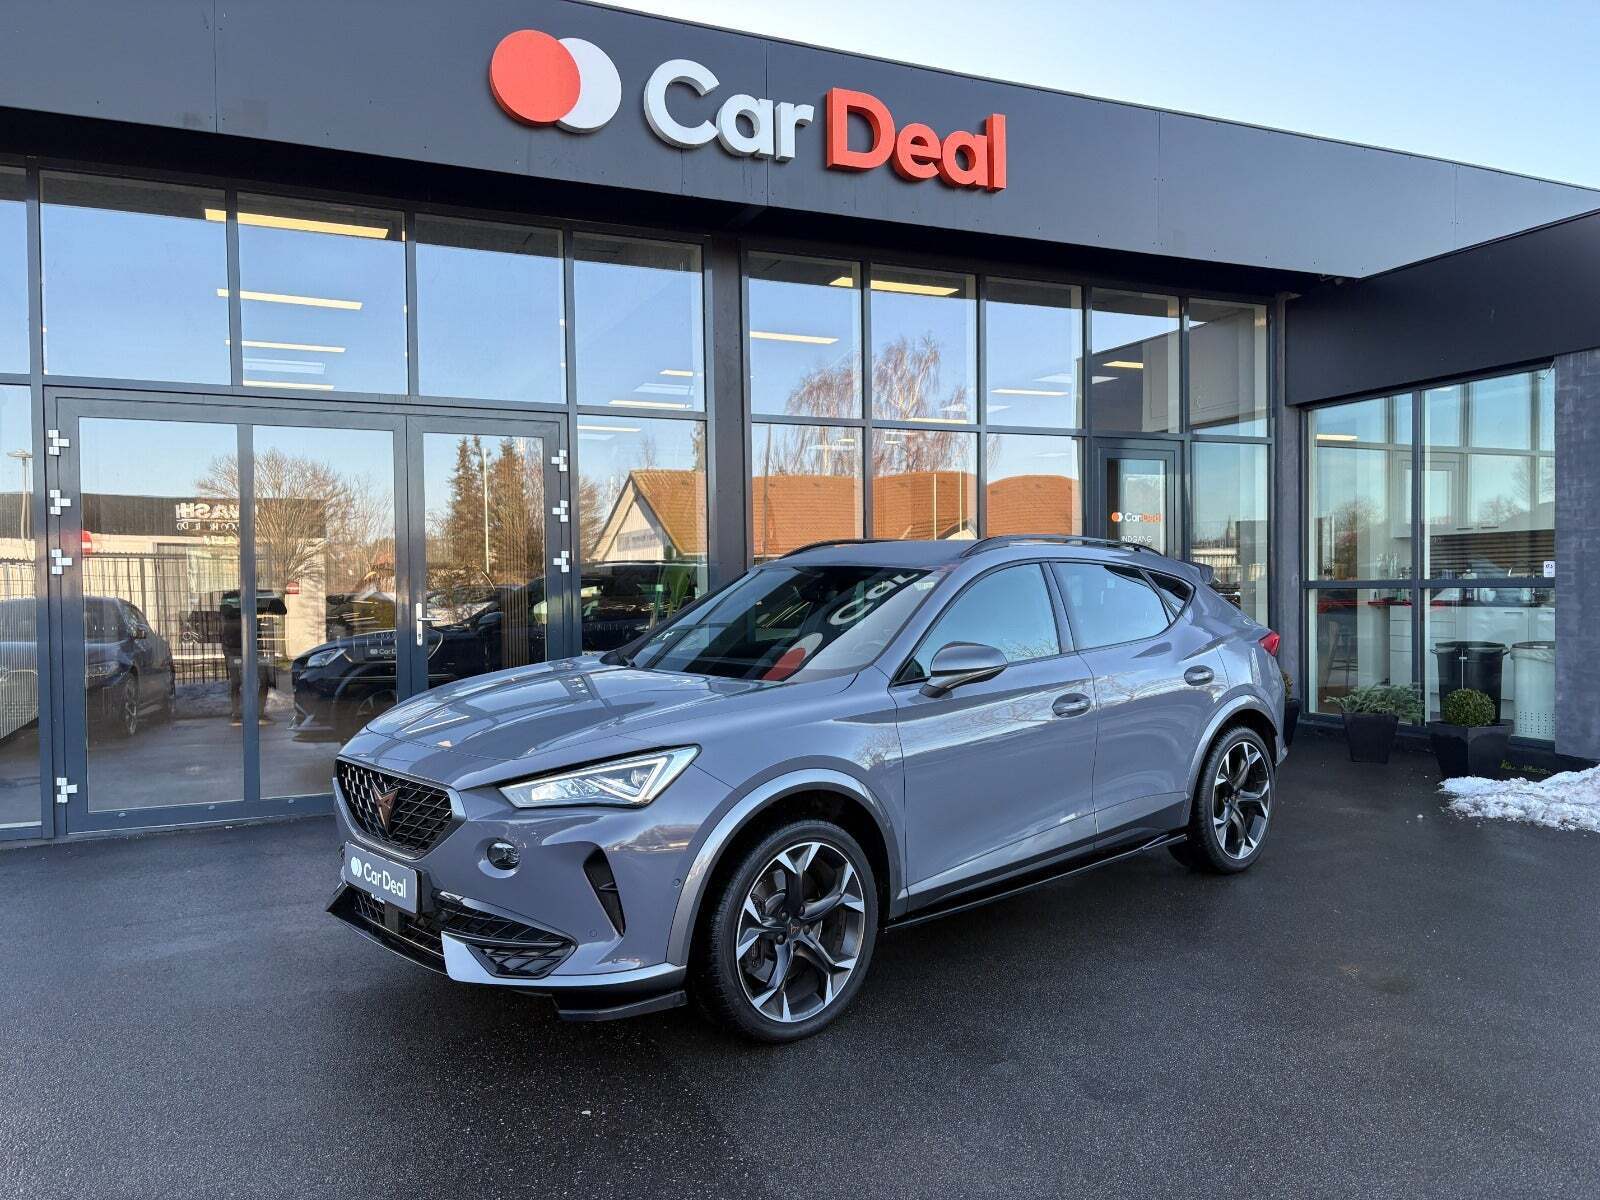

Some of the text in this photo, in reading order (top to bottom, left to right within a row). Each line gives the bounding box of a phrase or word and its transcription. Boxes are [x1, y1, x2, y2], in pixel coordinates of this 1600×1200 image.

[643, 59, 1007, 192] Car Deal
[1124, 512, 1142, 522] Car
[363, 862, 407, 899] Car Deal
